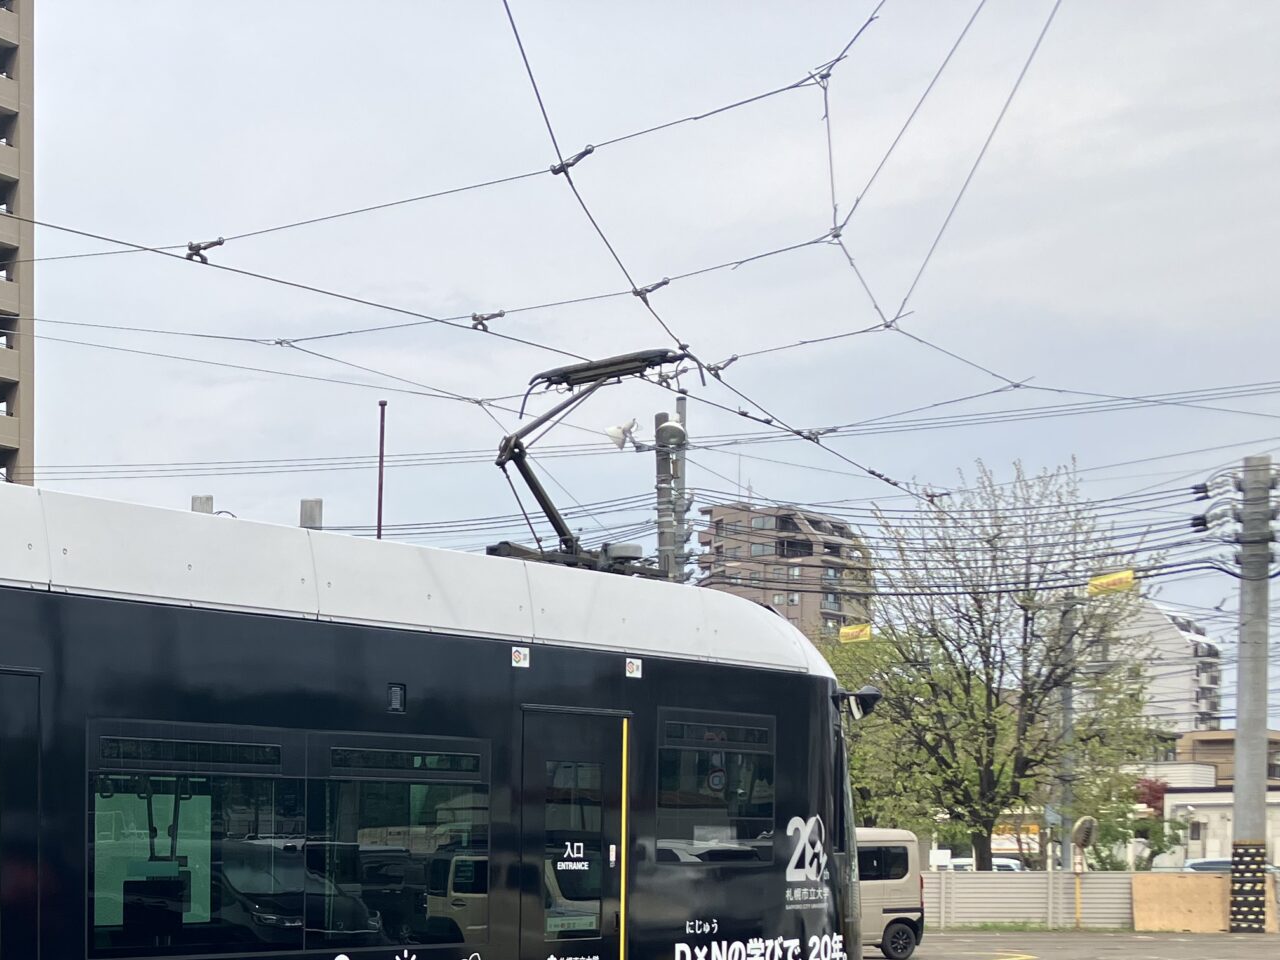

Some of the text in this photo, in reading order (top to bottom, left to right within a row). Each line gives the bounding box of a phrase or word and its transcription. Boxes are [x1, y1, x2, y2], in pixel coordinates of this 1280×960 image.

[563, 841, 584, 858] 入口
[557, 861, 589, 870] ENTRANCE
[685, 919, 719, 934] にじゅう
